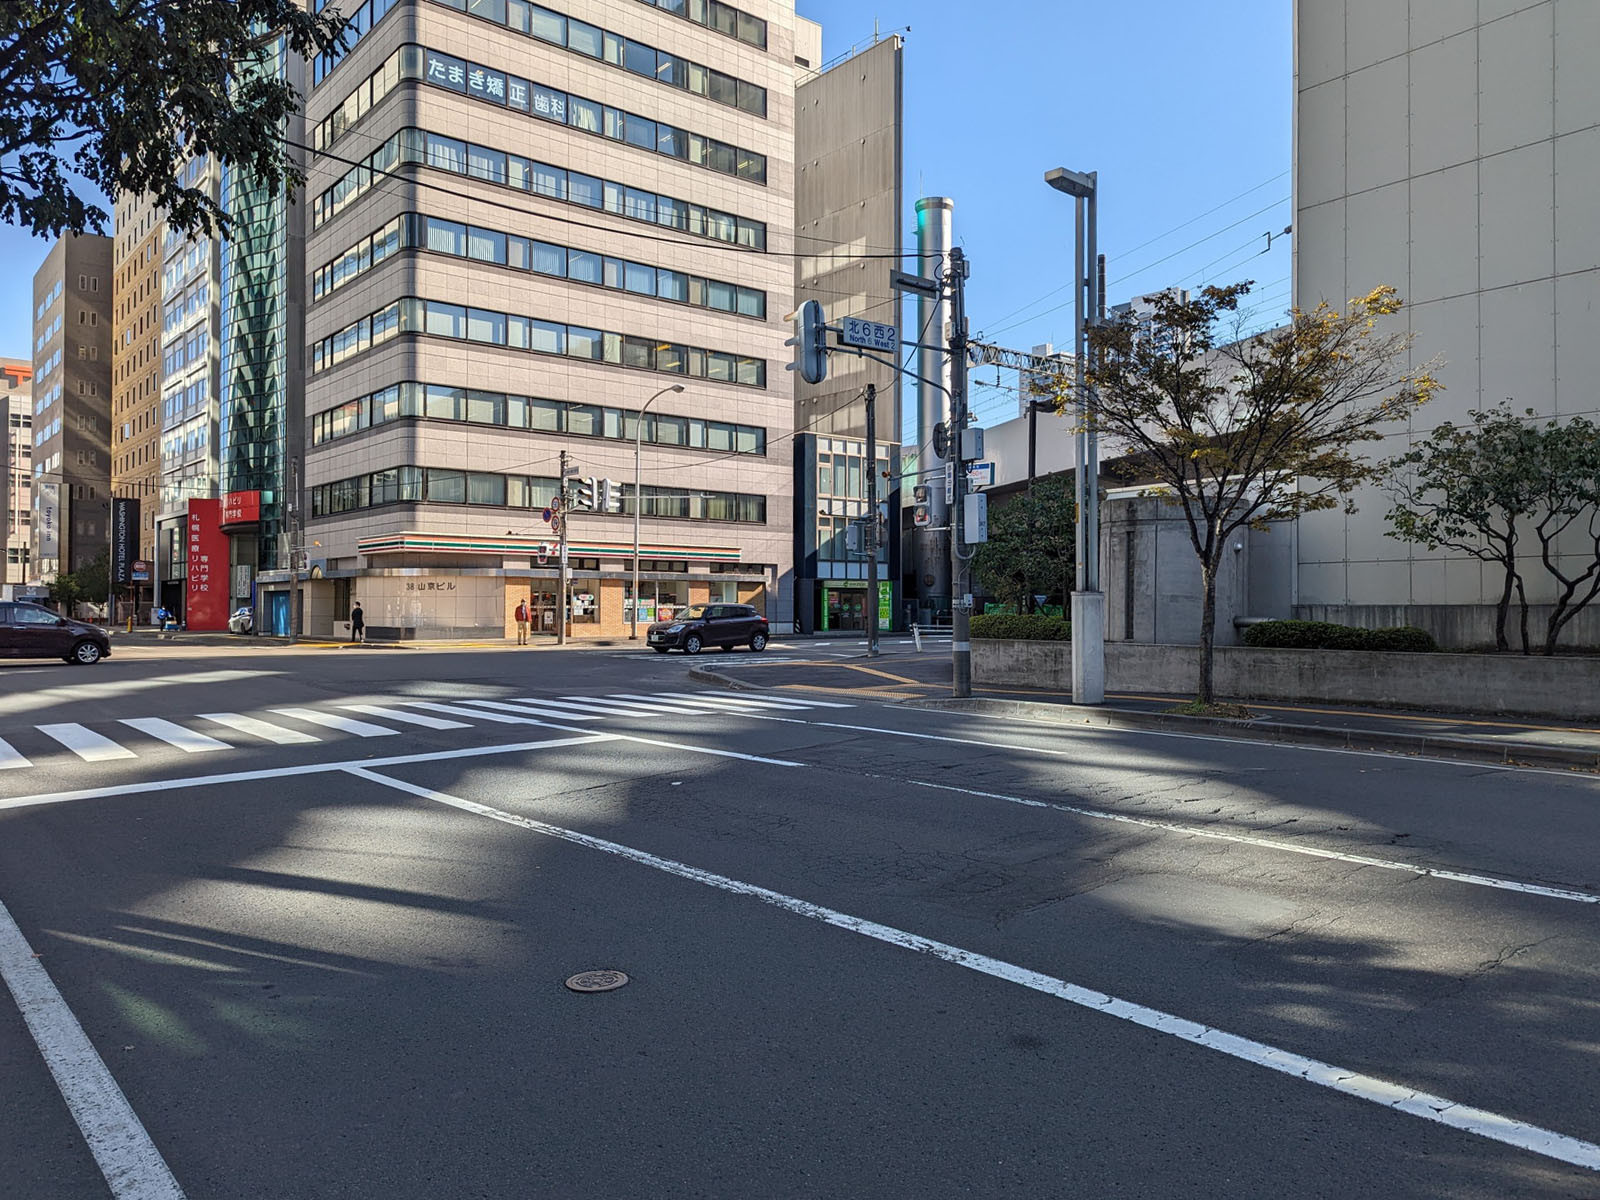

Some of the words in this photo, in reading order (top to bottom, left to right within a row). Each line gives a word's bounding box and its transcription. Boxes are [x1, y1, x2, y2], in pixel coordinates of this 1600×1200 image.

[428, 58, 565, 118] たまき矯正歯科
[849, 320, 896, 342] 北6西2
[850, 335, 866, 344] North
[867, 337, 873, 345] 6
[874, 339, 890, 349] West
[890, 342, 896, 350] 2
[118, 563, 126, 582] PLAZA
[200, 555, 209, 592] 専門学校
